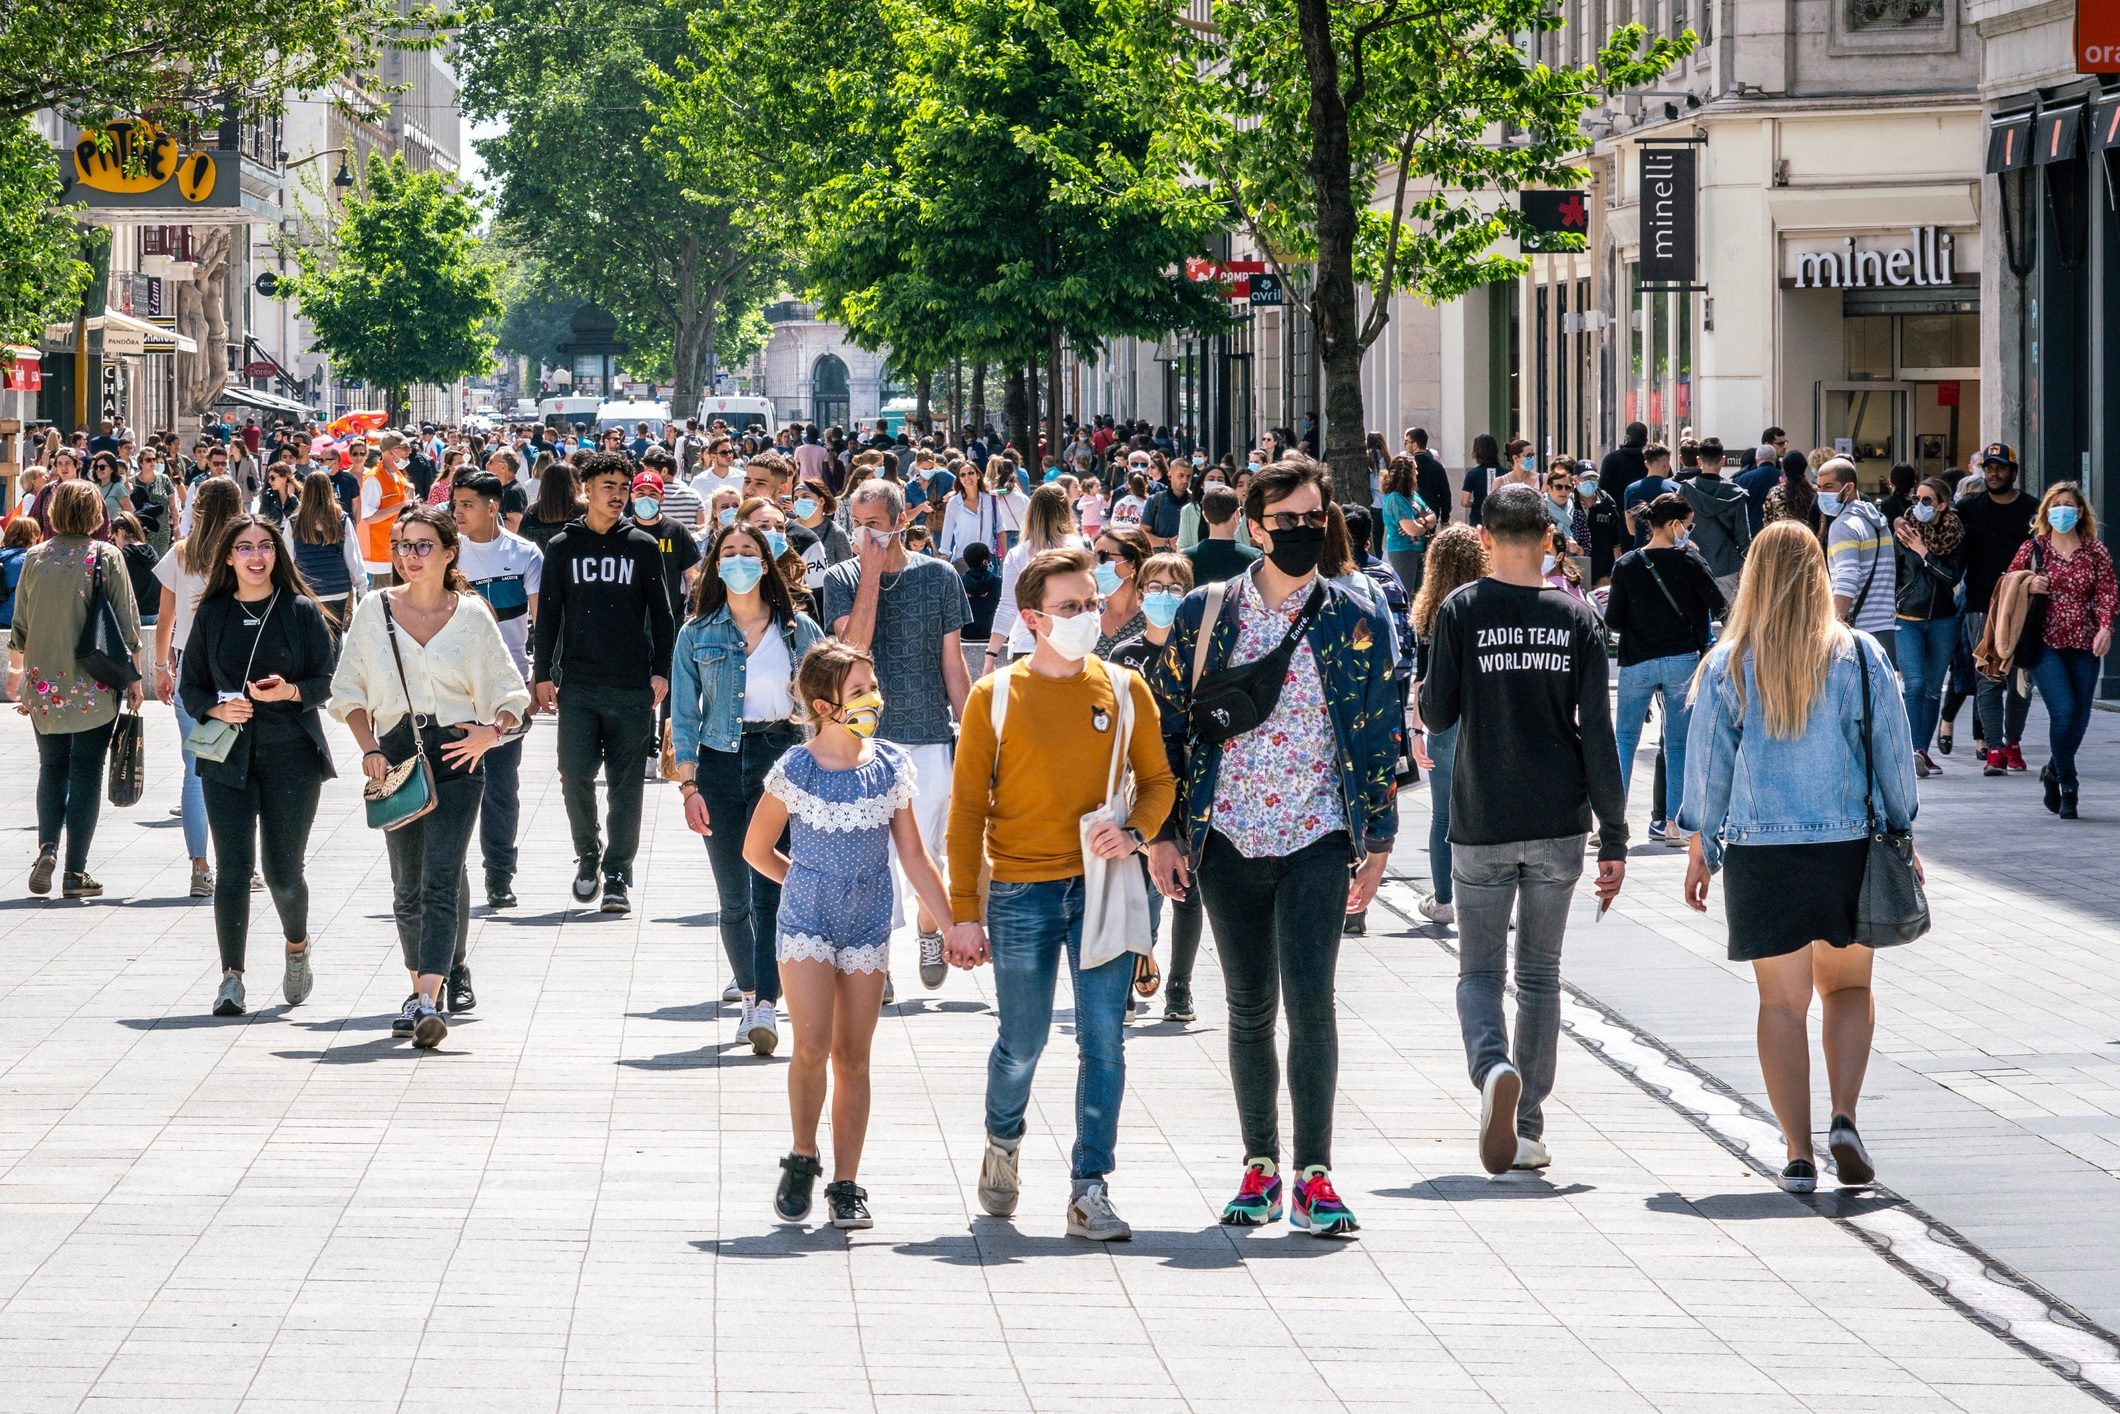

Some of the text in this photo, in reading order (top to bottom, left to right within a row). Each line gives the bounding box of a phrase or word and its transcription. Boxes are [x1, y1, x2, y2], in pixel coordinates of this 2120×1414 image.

[1645, 155, 1673, 259] minelli
[1794, 226, 1953, 288] minelli
[1220, 271, 1261, 284] CAMP
[149, 281, 160, 315] Etam
[1251, 289, 1282, 301] avril
[572, 557, 634, 585] ICON
[1477, 627, 1570, 648] ZADIG TEAM
[1478, 652, 1571, 673] WORLDWIDE
